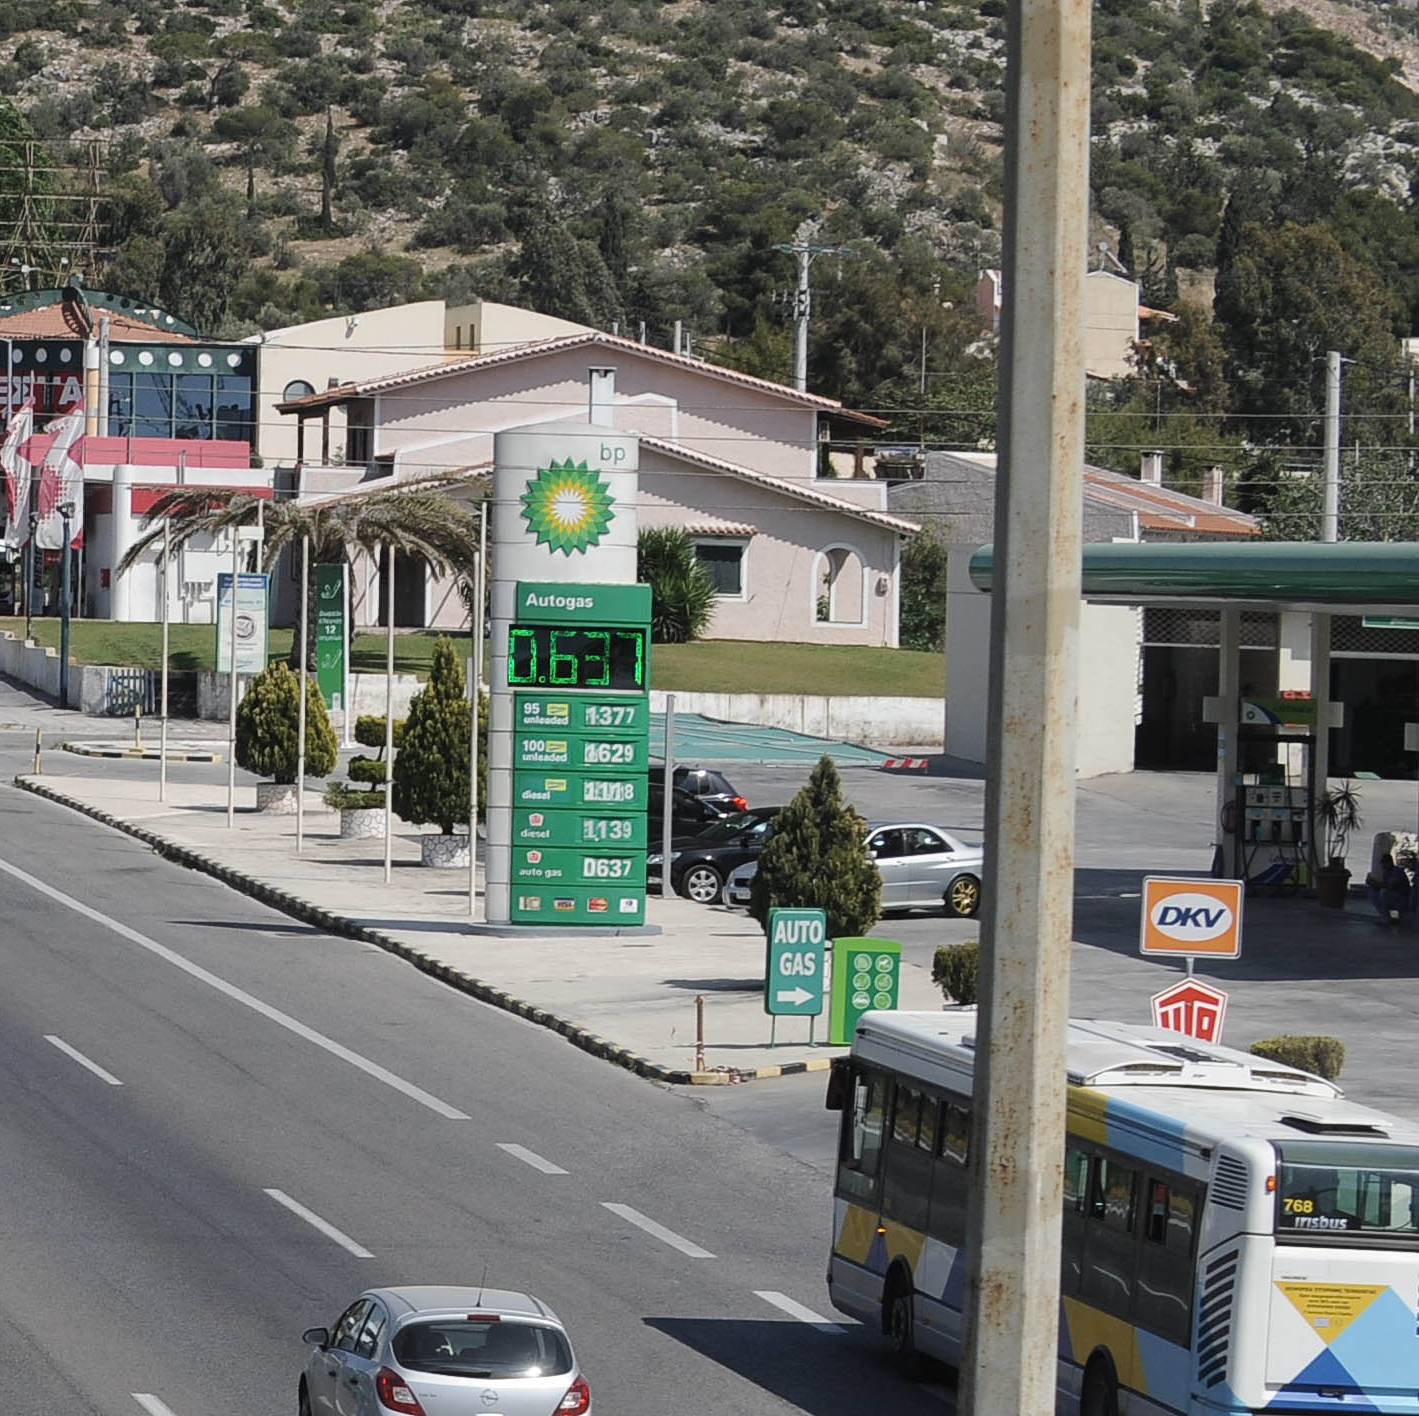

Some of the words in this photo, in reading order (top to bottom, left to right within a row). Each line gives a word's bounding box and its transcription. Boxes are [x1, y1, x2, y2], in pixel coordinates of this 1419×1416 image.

[599, 443, 626, 465] bp
[525, 592, 594, 610] Autogas
[523, 703, 540, 715] 95
[523, 716, 569, 726] unleaded
[522, 740, 545, 752] 100
[522, 753, 568, 763] unleaded
[521, 790, 551, 801] diesel
[520, 828, 550, 839] diesel
[518, 868, 543, 877] auto
[544, 869, 563, 879] gas
[1157, 906, 1226, 928] DKV
[774, 919, 823, 944] AUTO
[779, 952, 816, 977] GAS
[1283, 1198, 1313, 1214] 768
